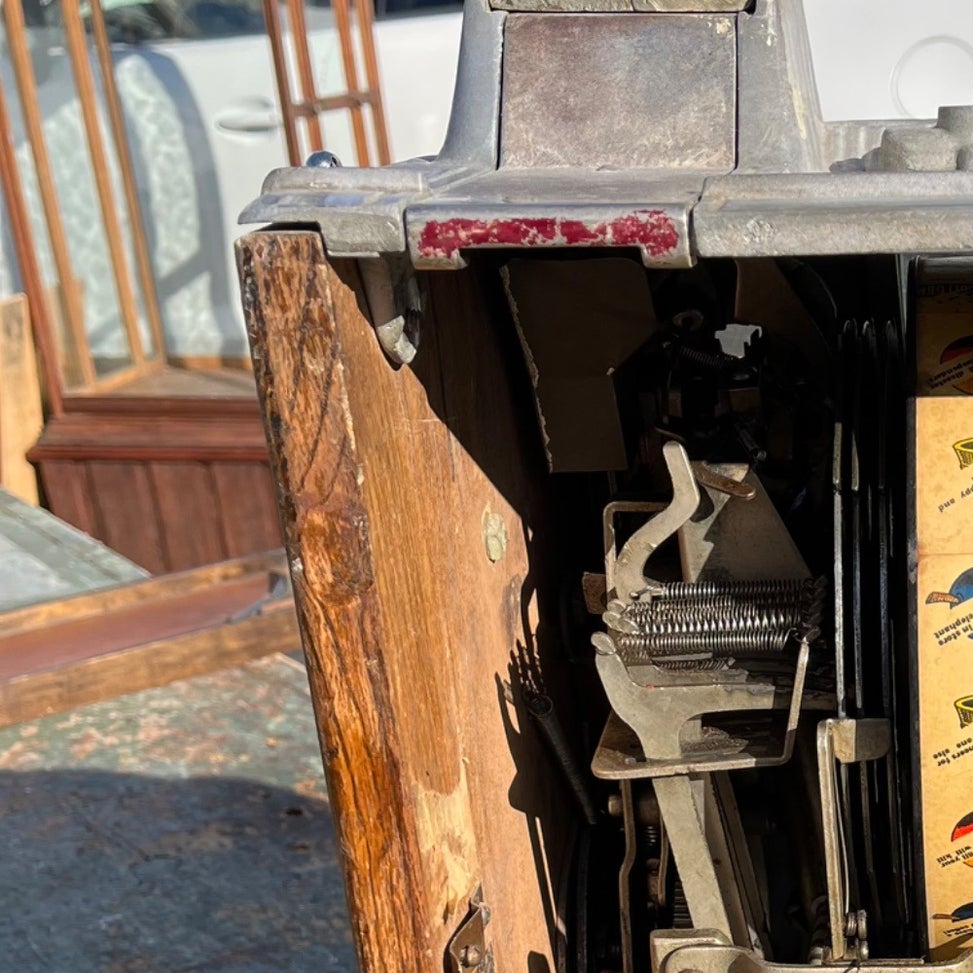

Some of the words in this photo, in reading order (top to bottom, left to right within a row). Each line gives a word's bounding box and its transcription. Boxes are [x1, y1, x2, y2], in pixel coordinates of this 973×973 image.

[938, 498, 956, 512] and
[934, 613, 973, 639] elephant
[963, 623, 973, 633] in
[938, 631, 961, 646] store
[956, 738, 972, 749] one
[933, 748, 950, 759] else
[937, 756, 950, 766] for
[955, 845, 972, 855] will
[962, 851, 973, 859] fill
[936, 854, 952, 862] kill
[941, 855, 960, 868] your
